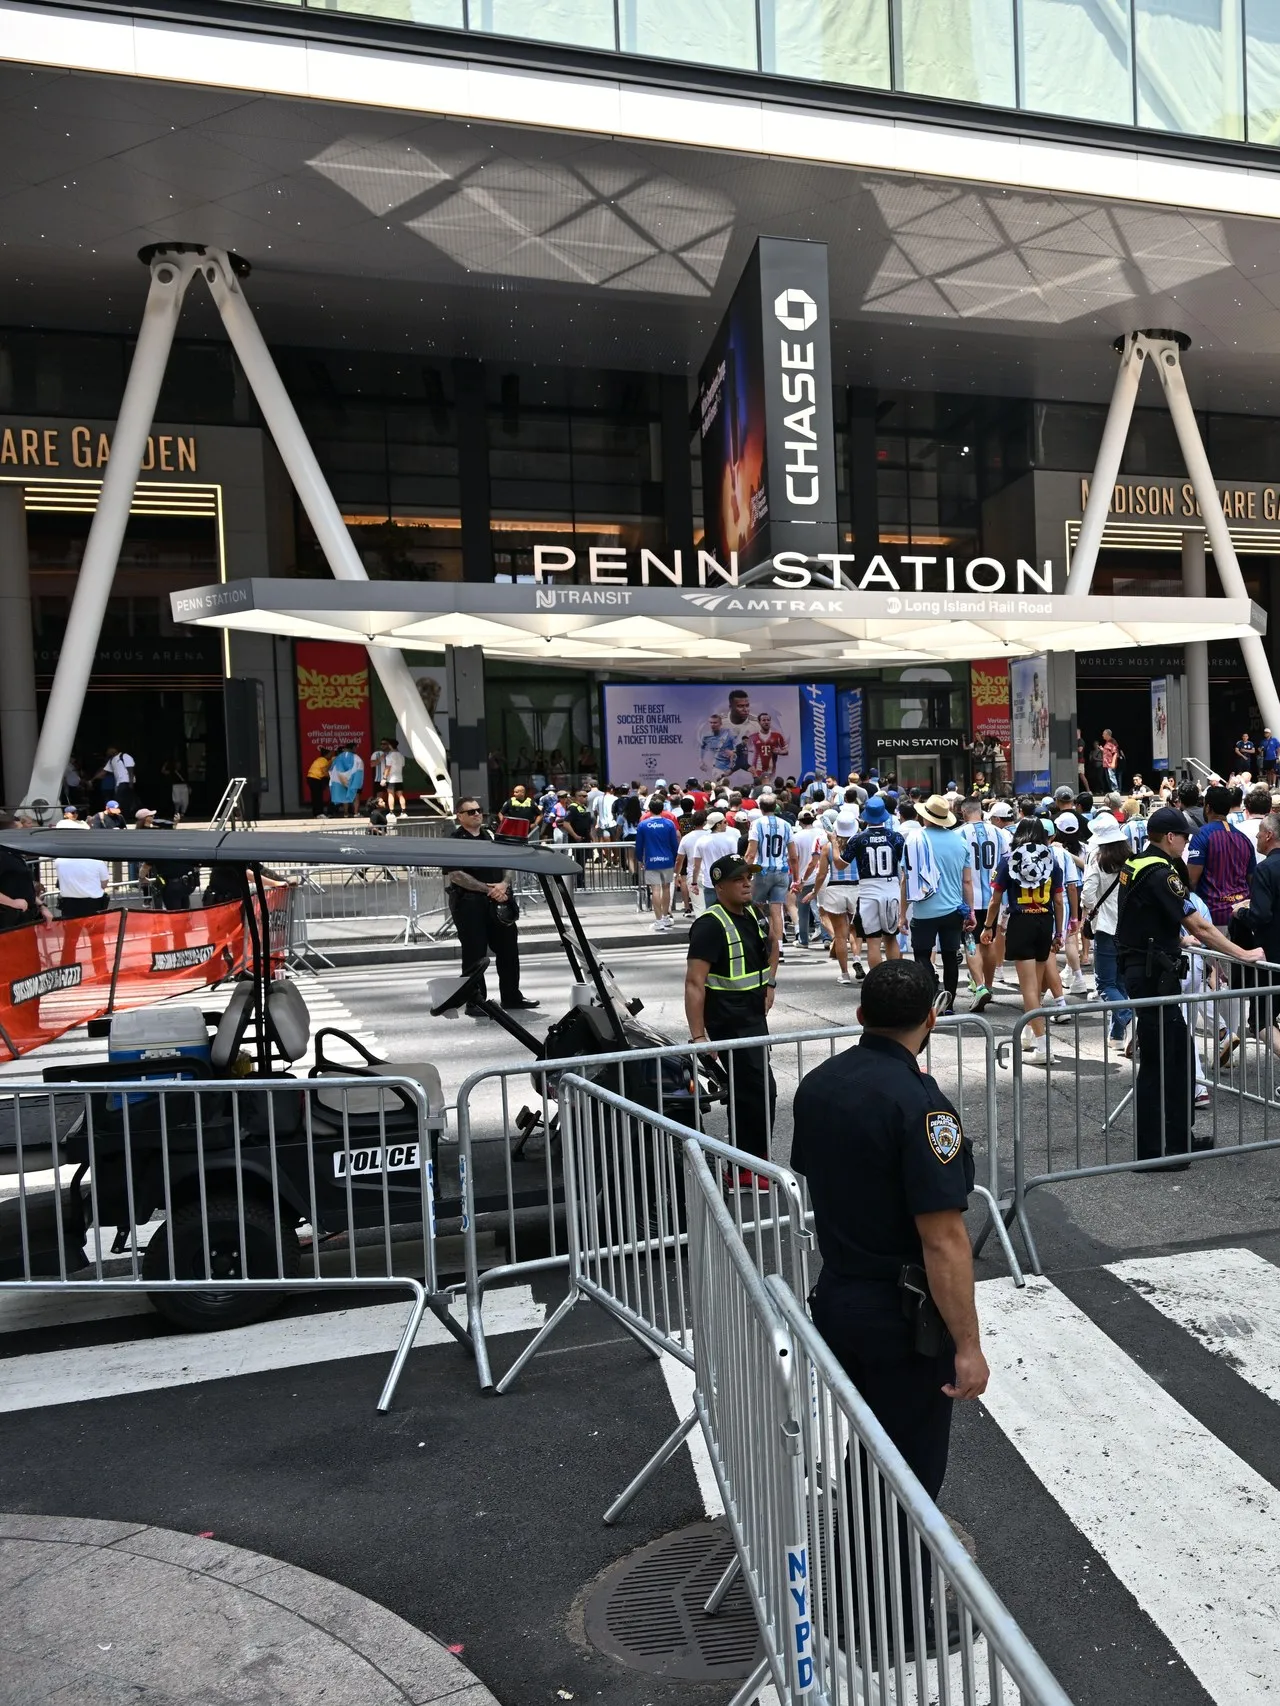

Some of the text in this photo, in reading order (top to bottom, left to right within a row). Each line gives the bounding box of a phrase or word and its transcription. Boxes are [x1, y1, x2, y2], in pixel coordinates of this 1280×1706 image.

[781, 340, 819, 505] CHASE
[71, 426, 197, 472] GADEN
[1182, 484, 1256, 519] SARE
[533, 545, 1053, 594] PENN STATION
[177, 590, 246, 612] PENN STATION
[557, 590, 632, 605] TRANSIT
[727, 600, 843, 612] AMTRAK
[905, 601, 939, 614] Long
[943, 601, 985, 613] Island
[988, 602, 1014, 613] Rail
[1017, 602, 1052, 614] Road
[152, 651, 204, 661] ARENA
[1079, 658, 1123, 666] WORLD'S
[297, 665, 368, 686] No one
[337, 685, 369, 698] you
[306, 697, 363, 710] closer
[977, 695, 1009, 706] close
[633, 704, 665, 714] THE BEST
[617, 714, 682, 725] SOCCER ON EARTH.
[307, 730, 364, 739] official sponsor
[632, 725, 669, 735] LESS THAN
[617, 735, 684, 745] A TICKET TO JERSEY.
[877, 738, 959, 748] PENN STATION
[765, 834, 784, 858] 10
[866, 846, 893, 876] 10
[971, 841, 996, 870] 10
[788, 1549, 813, 1689] NYPD
